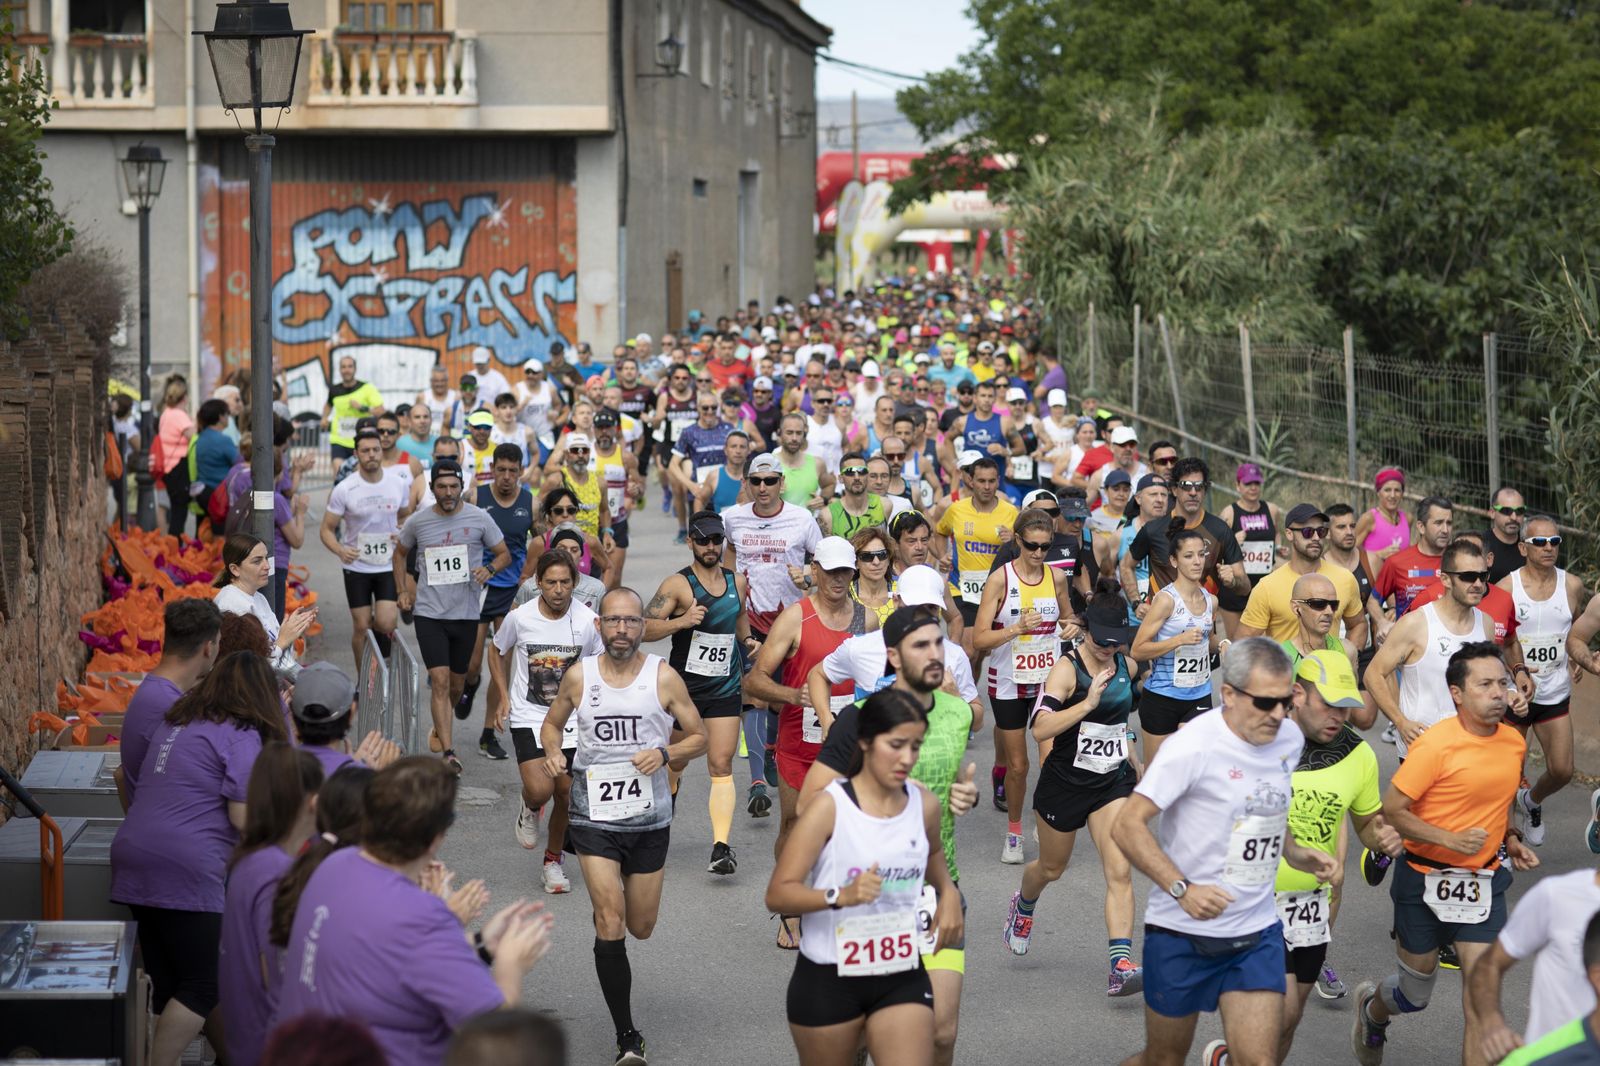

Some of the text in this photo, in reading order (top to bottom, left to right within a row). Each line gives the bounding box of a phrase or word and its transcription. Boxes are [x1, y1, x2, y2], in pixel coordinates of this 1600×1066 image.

[292, 192, 498, 276] PONY
[364, 543, 387, 555] 315
[760, 538, 786, 546] MARATÓN
[434, 557, 461, 571] 118
[1242, 552, 1271, 562] 2042
[699, 645, 728, 662] 785
[1016, 652, 1055, 669] 2085
[1527, 647, 1557, 662] 480
[1177, 655, 1209, 673] 2211
[1081, 738, 1123, 757] 2201
[599, 779, 642, 801] 274
[1243, 835, 1281, 861] 875
[1437, 880, 1480, 902] 643
[1285, 901, 1322, 926] 742
[843, 934, 912, 965] 2185
